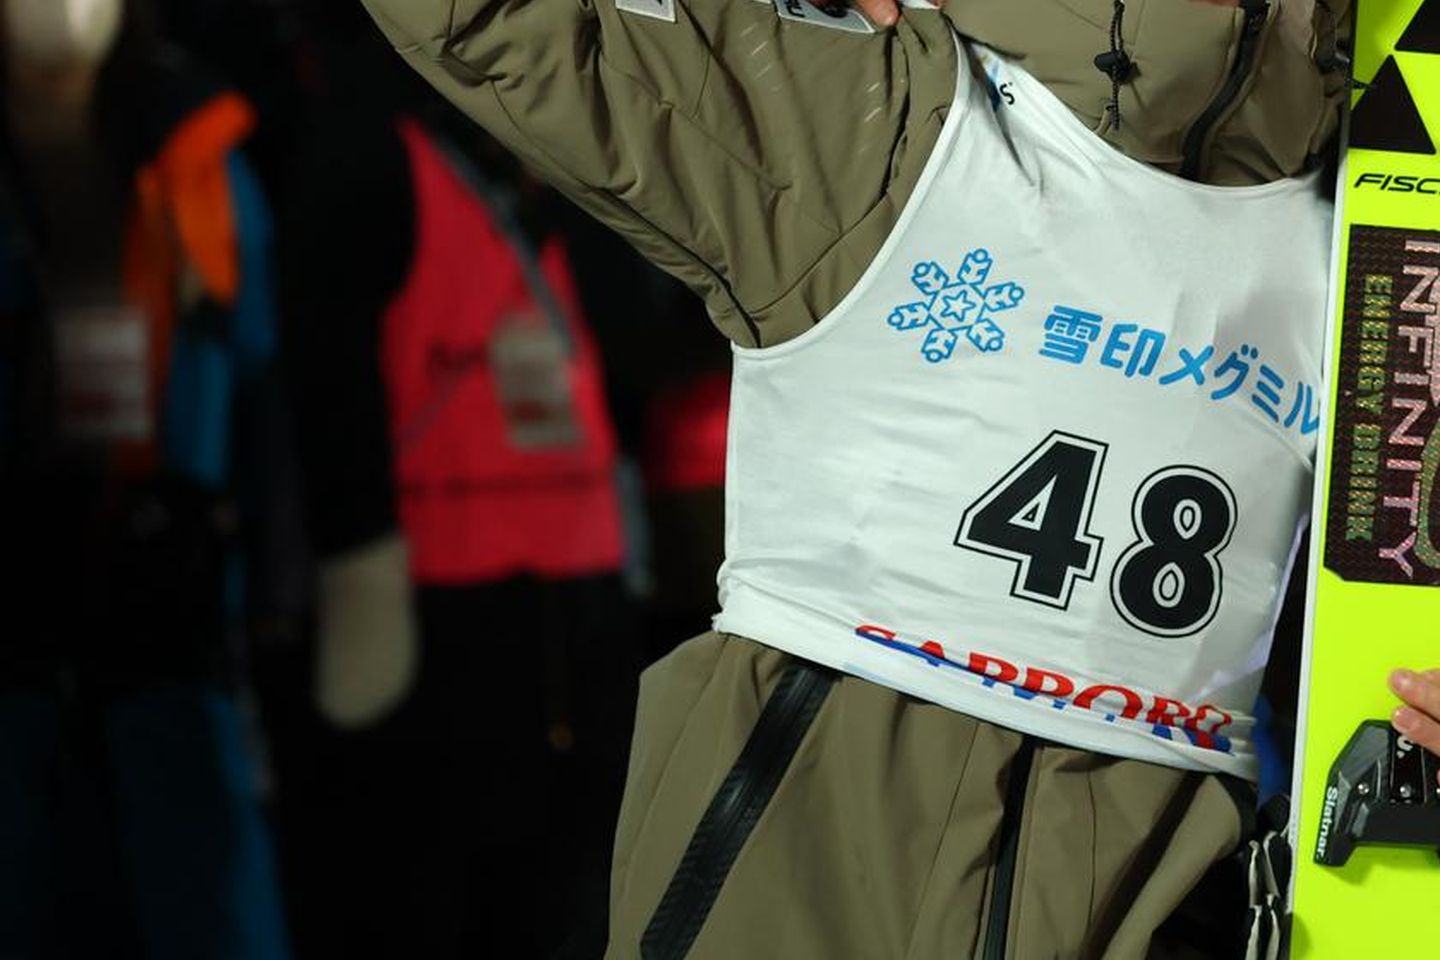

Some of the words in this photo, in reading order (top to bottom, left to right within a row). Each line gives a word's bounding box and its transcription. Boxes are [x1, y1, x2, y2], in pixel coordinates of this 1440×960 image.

[1356, 274, 1393, 416] ENERGY
[1379, 241, 1440, 578] INFINITY
[953, 429, 1238, 638] 48
[1346, 424, 1382, 541] DRINK
[1317, 787, 1339, 856] Slatnar
